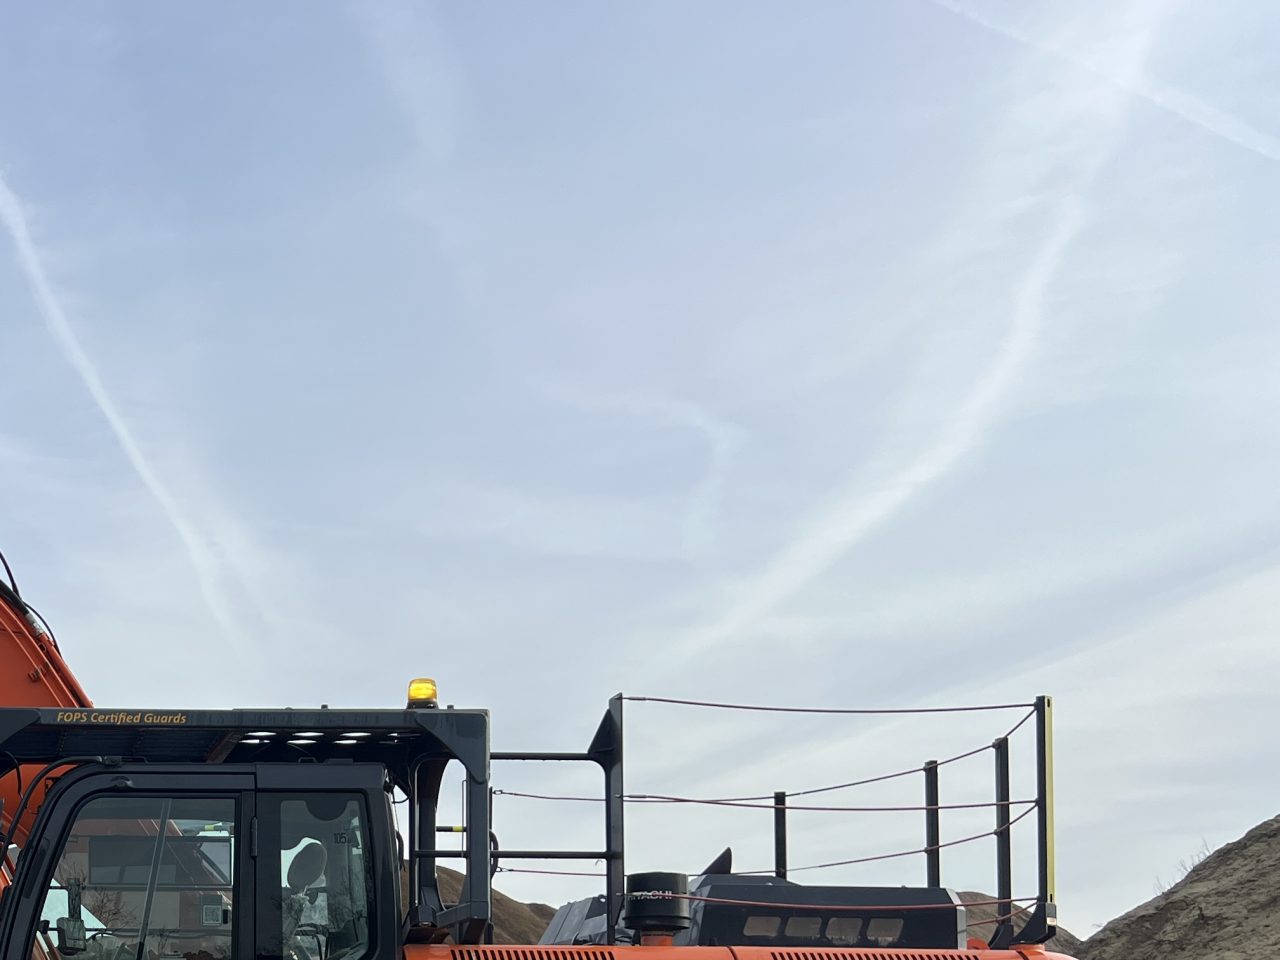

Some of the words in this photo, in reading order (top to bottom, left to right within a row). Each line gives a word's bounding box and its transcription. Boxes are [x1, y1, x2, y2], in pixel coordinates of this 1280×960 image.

[57, 712, 88, 722] FOPS
[91, 712, 142, 724] Certified
[144, 713, 187, 724] Guards
